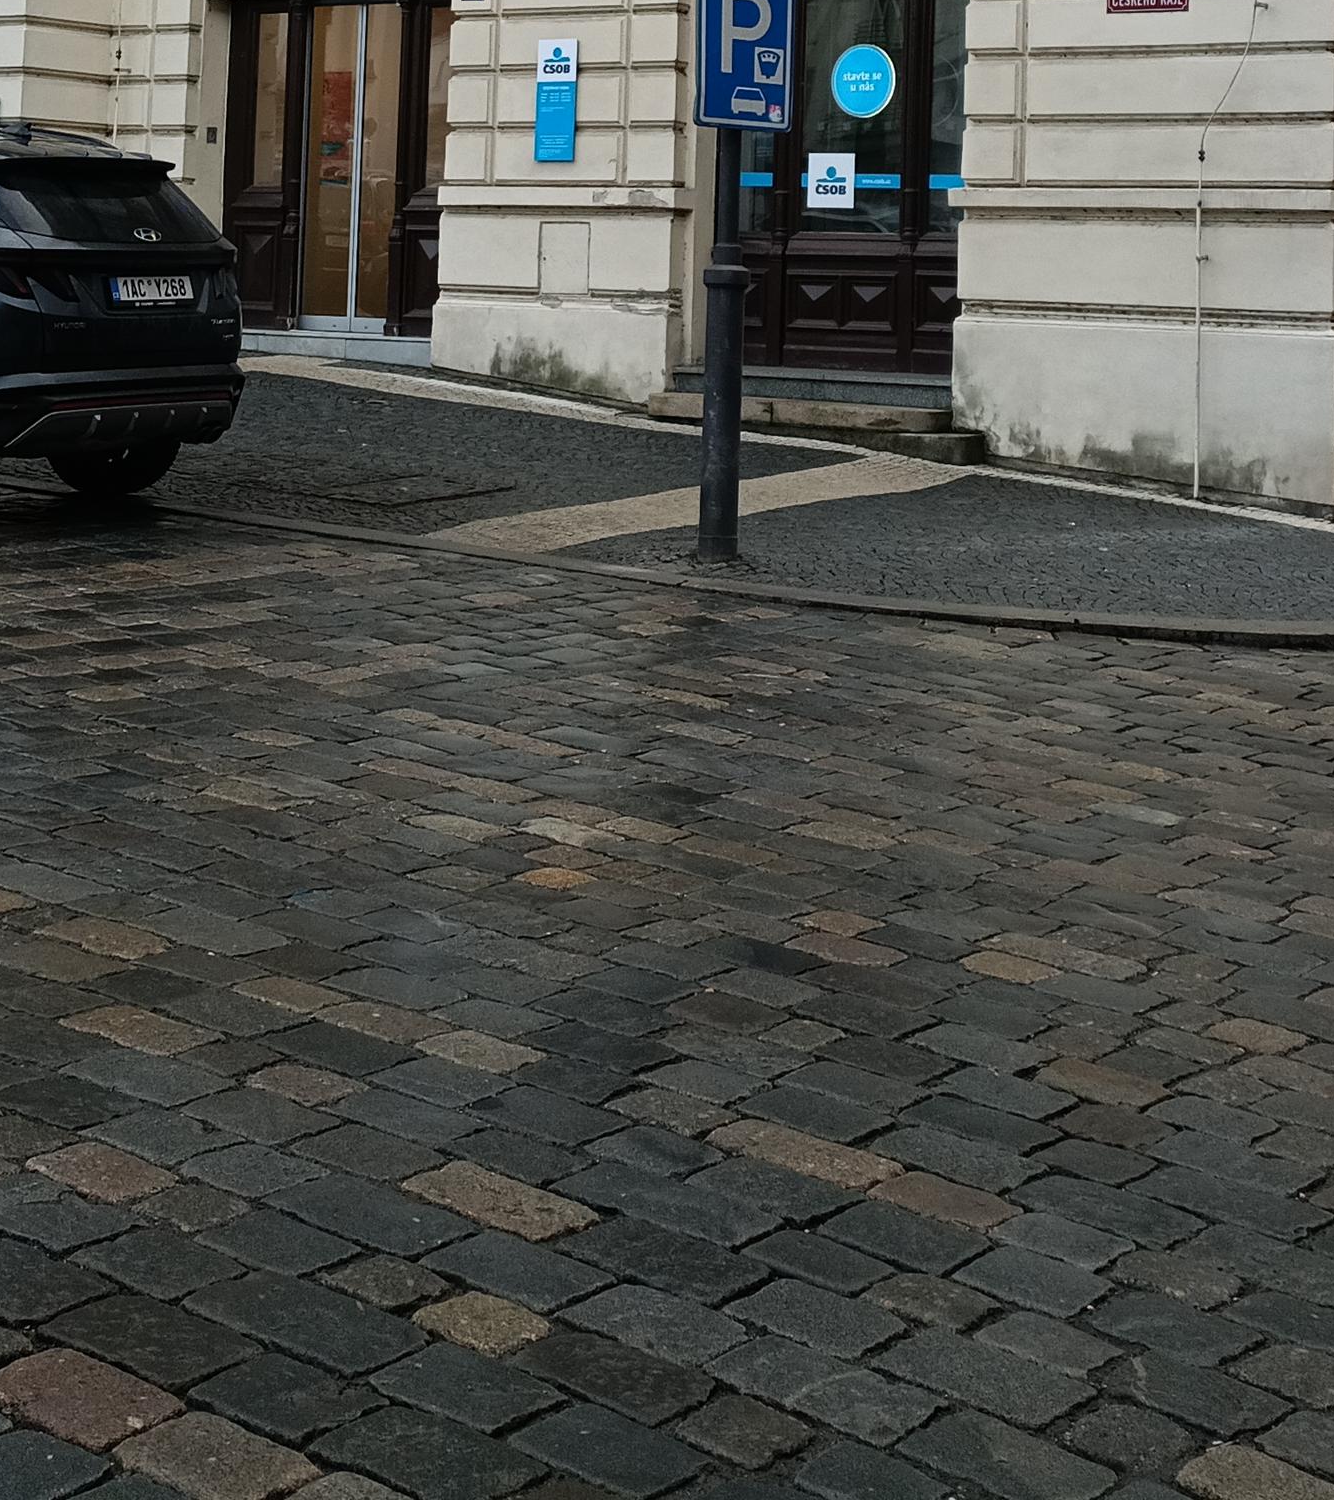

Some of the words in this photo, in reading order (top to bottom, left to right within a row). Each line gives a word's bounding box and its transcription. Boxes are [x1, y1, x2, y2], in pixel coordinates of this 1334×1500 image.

[842, 70, 870, 81] stavte
[872, 71, 883, 81] se
[858, 82, 875, 92] nás
[815, 183, 847, 196] ČSOB
[122, 279, 148, 299] 1AC
[155, 277, 187, 298] Y268
